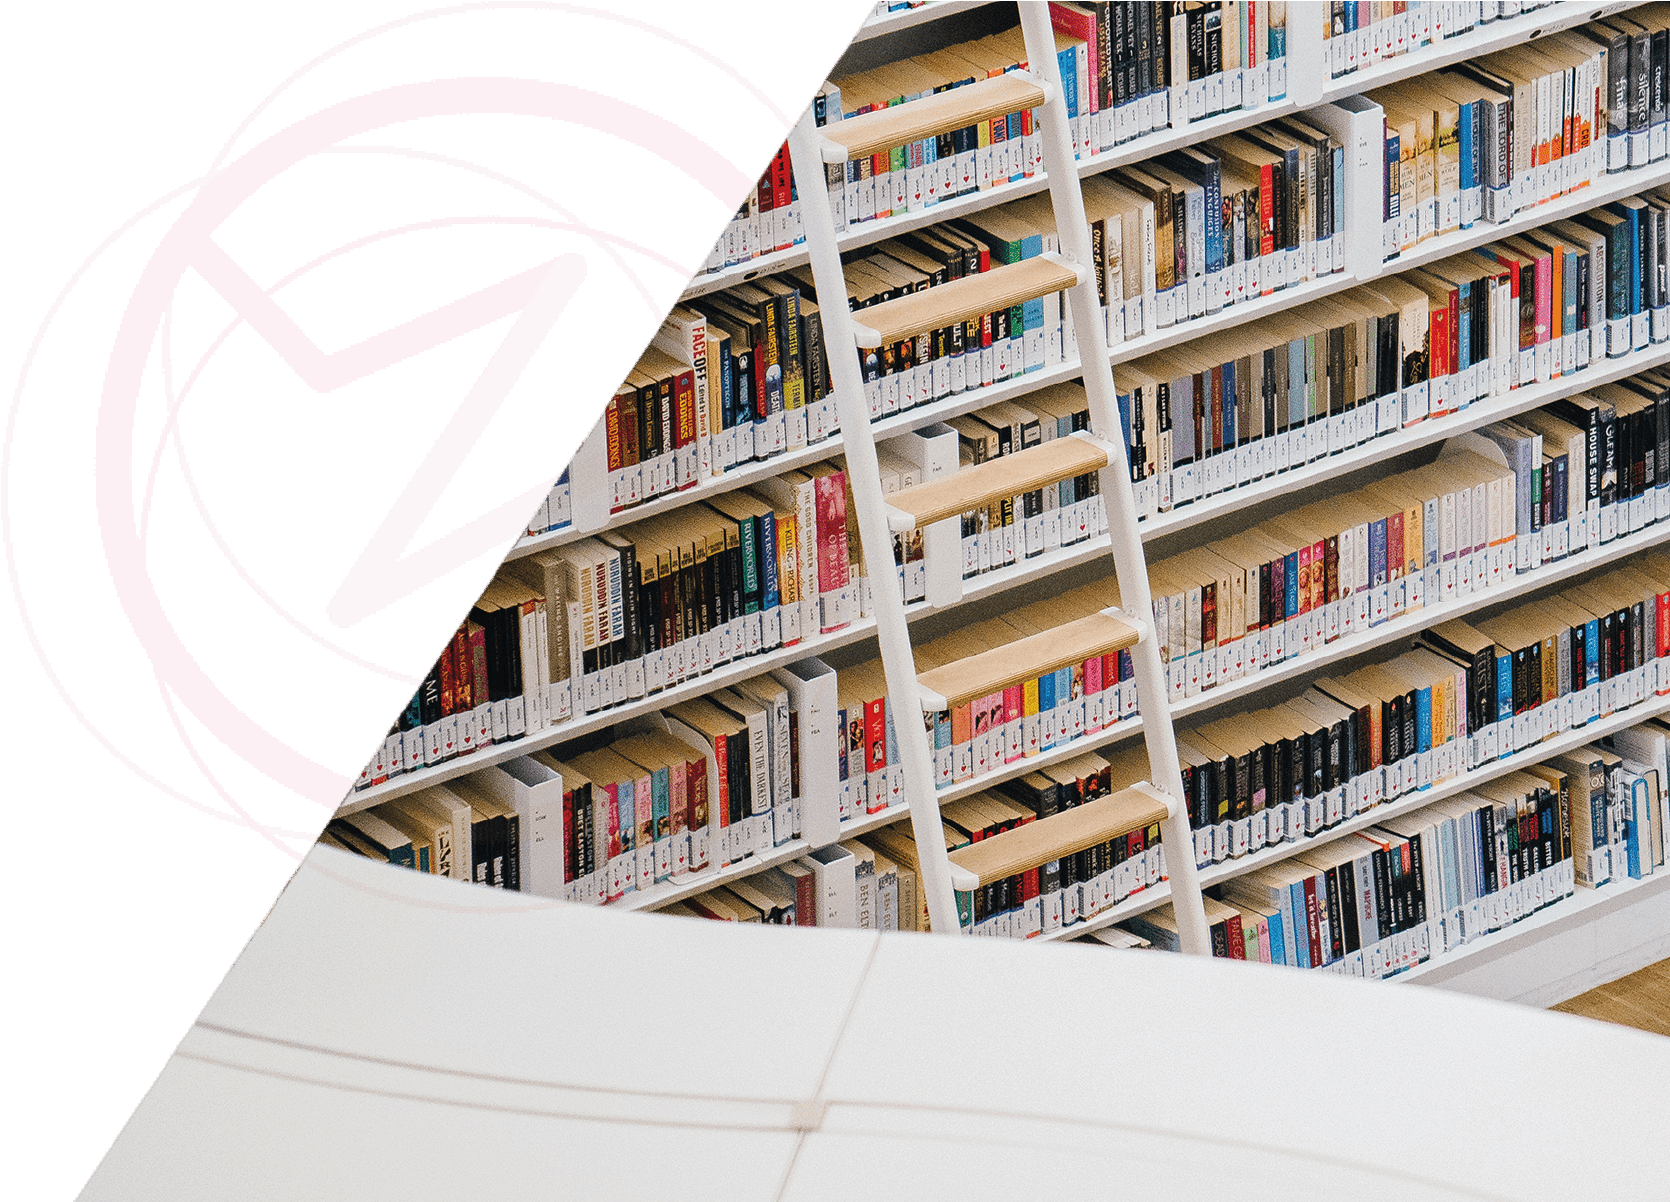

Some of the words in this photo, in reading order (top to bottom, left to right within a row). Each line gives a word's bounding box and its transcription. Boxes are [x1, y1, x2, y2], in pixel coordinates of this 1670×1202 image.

[1615, 79, 1627, 120] finale
[1638, 73, 1648, 122] silence
[1498, 107, 1506, 128] THE
[1499, 131, 1507, 161] LORD
[1499, 165, 1507, 179] OF
[766, 303, 775, 325] LINDA
[787, 297, 796, 318] LINDA
[767, 326, 777, 365] FAIRSTEIN
[788, 319, 798, 356] FAIRSTEIN
[692, 327, 707, 380] FACEOFF
[723, 361, 731, 408] PANOPTICON
[608, 411, 618, 435] DAVID
[661, 397, 670, 419] DAVID
[679, 393, 688, 439] EDDINGS
[698, 404, 705, 412] by
[699, 414, 707, 431] David
[609, 435, 619, 469] EDDINGS
[662, 420, 671, 453] EDDINGS
[1589, 428, 1598, 465] HOUSE
[1590, 468, 1598, 496] SWAP
[744, 523, 755, 589] RIVERWORLD
[764, 518, 774, 591] RIVERWORLD
[785, 530, 793, 561] KILLING
[805, 526, 813, 567] CHILDREN
[609, 557, 620, 603] NURUDDIN
[612, 607, 622, 637] FARAH
[425, 679, 437, 705] ME
[754, 731, 765, 753] EVEN
[756, 756, 765, 769] THE
[756, 770, 767, 808] DARKEST
[1310, 914, 1318, 940] breathe
